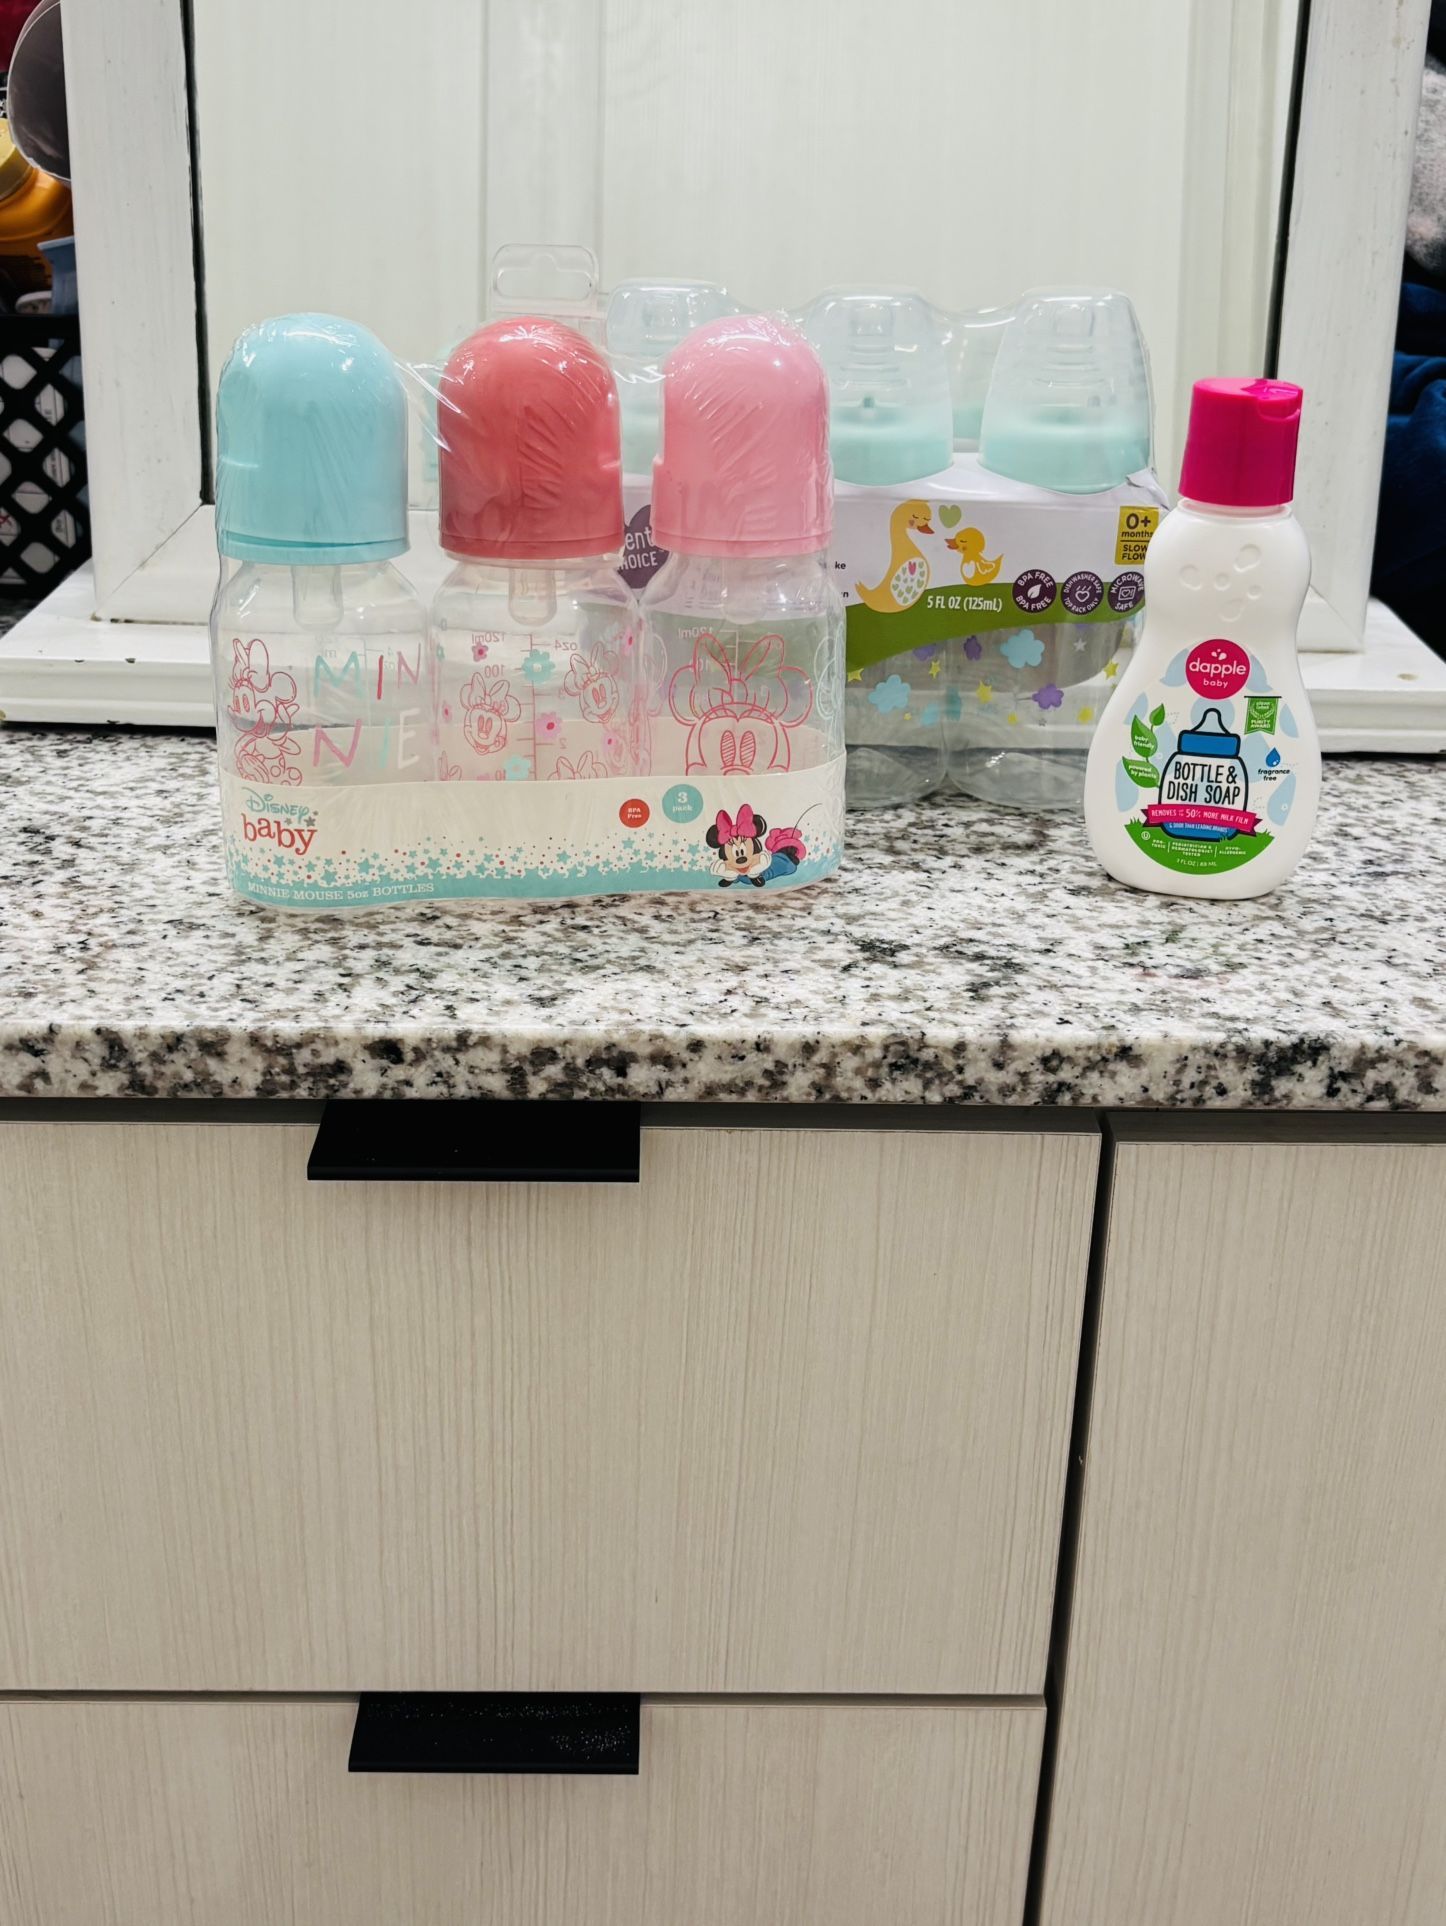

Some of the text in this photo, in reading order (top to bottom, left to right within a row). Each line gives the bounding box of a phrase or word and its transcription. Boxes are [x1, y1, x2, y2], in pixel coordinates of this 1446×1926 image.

[1126, 513, 1151, 530] 0+
[1017, 571, 1054, 588] BPA FREE
[1063, 573, 1096, 593] DISHWASHER
[1110, 573, 1145, 593] MICROWAVE
[927, 596, 1003, 612] 5 FL OZ (125mL)
[1016, 595, 1051, 610] BPA FREE
[1064, 597, 1099, 613] TOP RACK ONLY
[1114, 601, 1134, 611] SAFE
[1189, 658, 1247, 678] dapple
[1203, 678, 1228, 688] baby
[1174, 761, 1237, 784] BOTTLE &
[1257, 768, 1291, 776] fragrance
[678, 791, 688, 803] 3
[1167, 780, 1241, 805] DISH SOAP
[672, 804, 693, 813] pack
[1151, 809, 1176, 817] REMOVES
[1185, 809, 1201, 818] 50%
[1203, 811, 1218, 819] MORE
[1221, 813, 1233, 822] MILK
[1235, 815, 1248, 824] FILM
[241, 813, 317, 855] baby
[248, 882, 434, 900] MINNIE MOUSE 5oz BOTTLES
